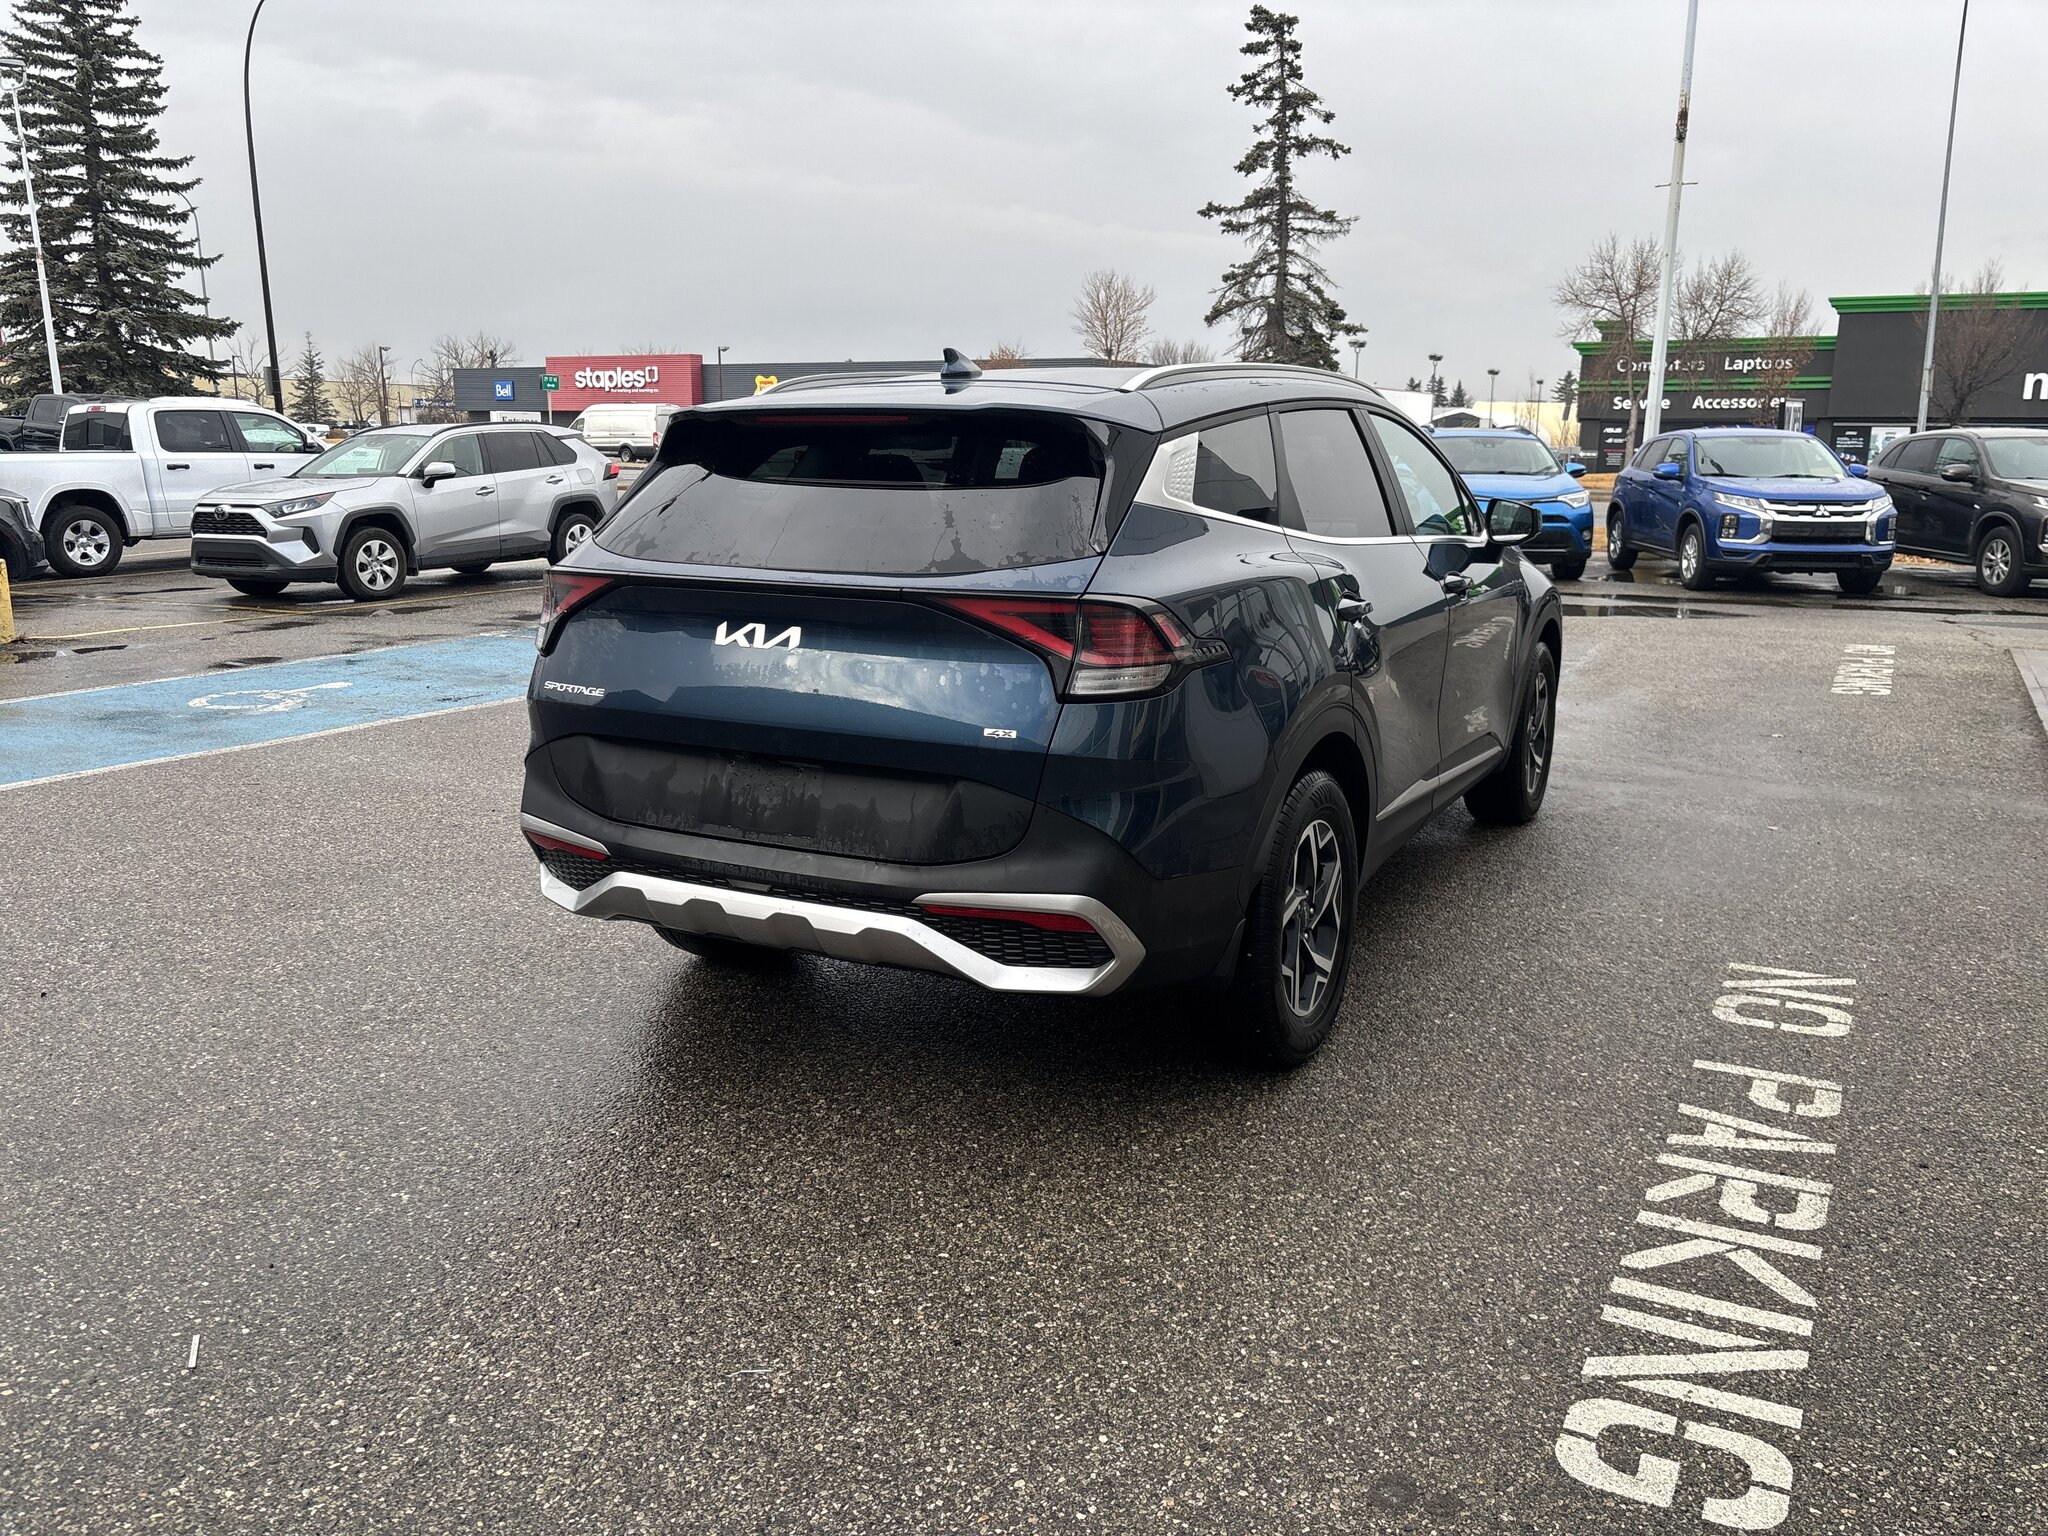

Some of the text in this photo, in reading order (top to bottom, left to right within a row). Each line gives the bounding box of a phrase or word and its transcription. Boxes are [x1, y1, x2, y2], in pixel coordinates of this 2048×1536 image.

[1617, 358, 1706, 373] Comters
[575, 366, 646, 391] staples
[495, 384, 512, 397] Bell
[1612, 395, 1785, 410] Seve Accessore
[543, 680, 606, 697] SPORTAGE
[1554, 961, 1857, 1532] NO PARKING
